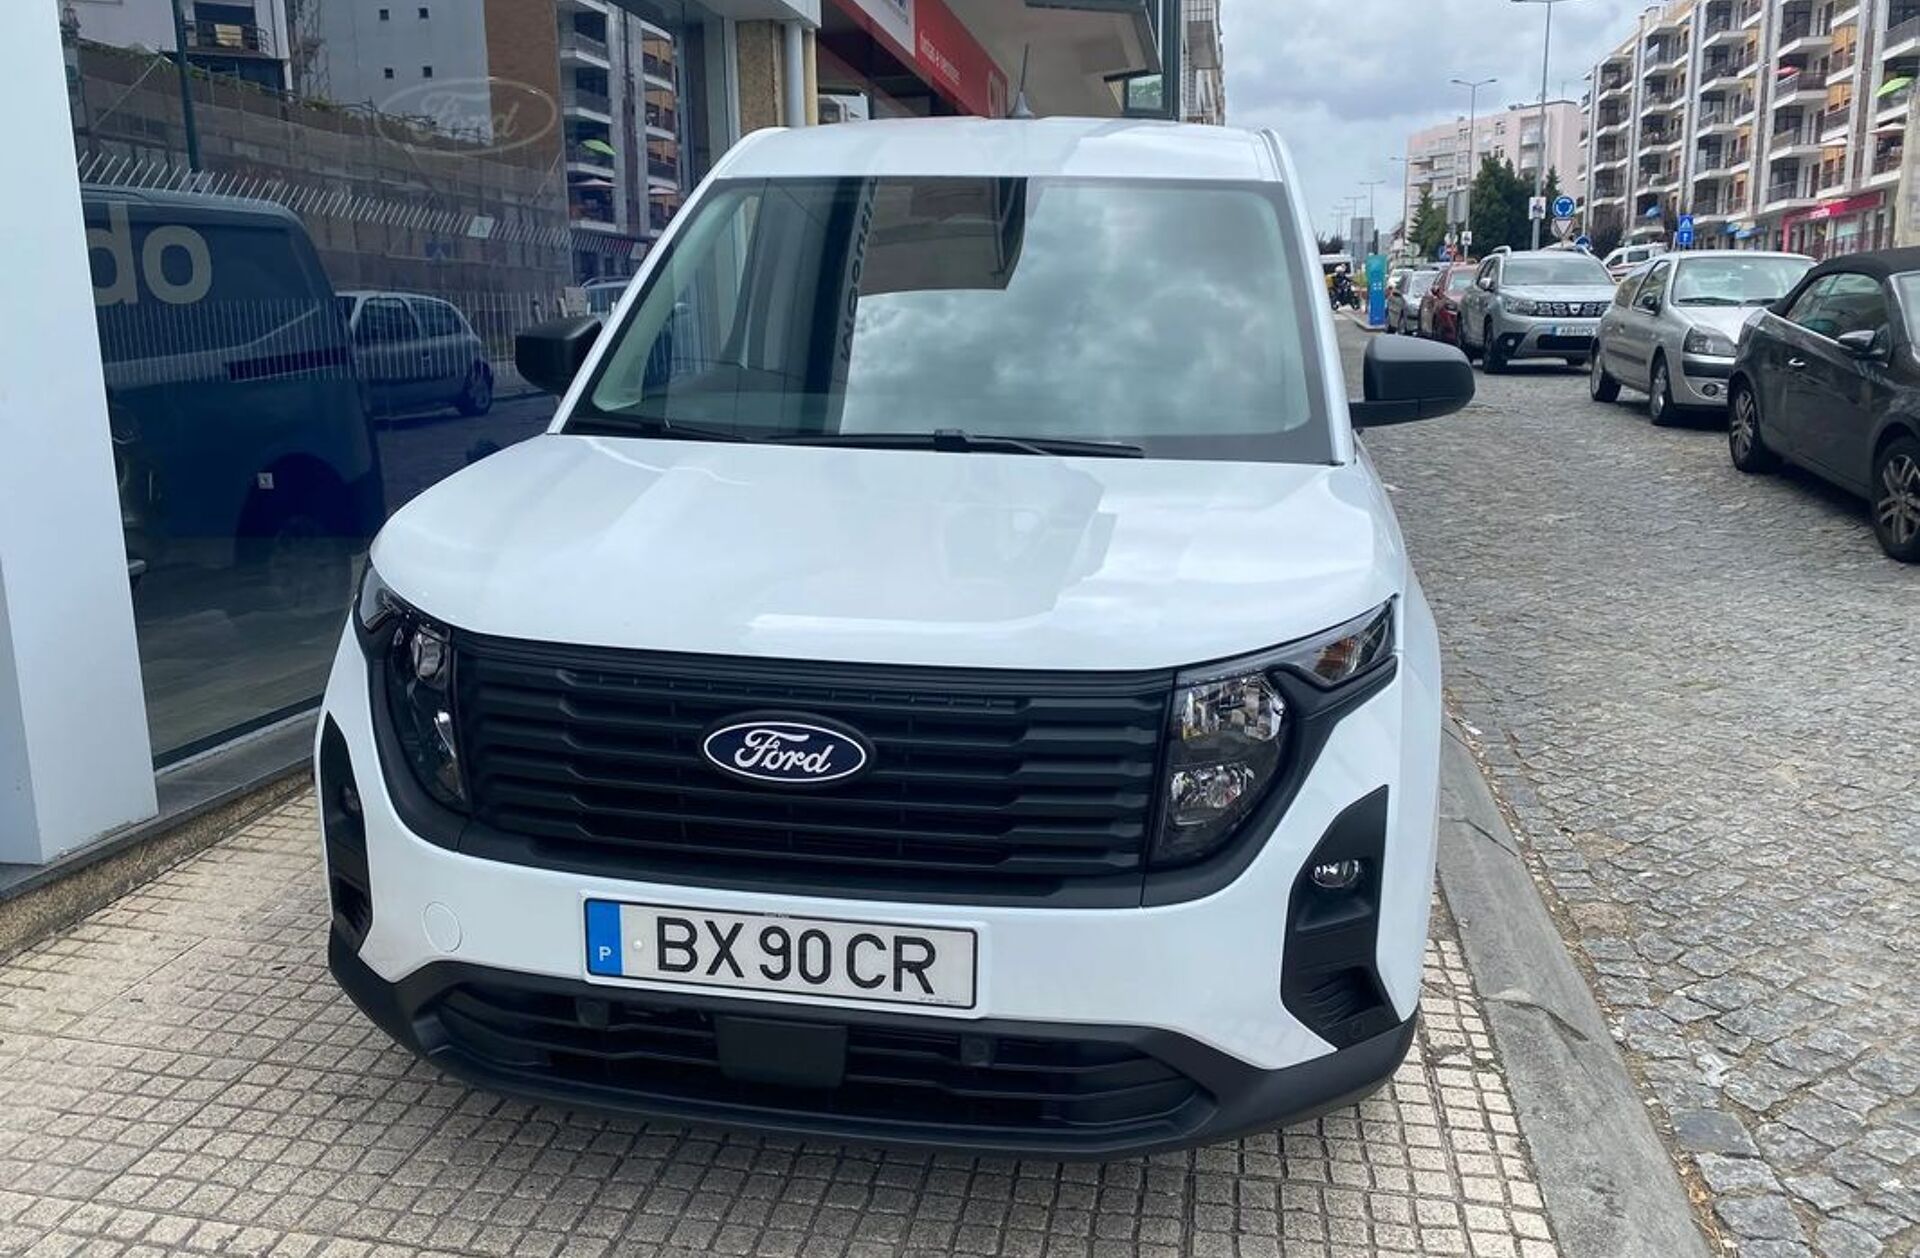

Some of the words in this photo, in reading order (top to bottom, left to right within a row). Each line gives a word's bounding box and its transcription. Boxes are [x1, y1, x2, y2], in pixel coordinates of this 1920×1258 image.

[734, 729, 835, 774] Ford
[599, 946, 612, 962] P
[656, 916, 745, 978] BX
[759, 926, 832, 985] 90
[846, 933, 937, 995] CR
